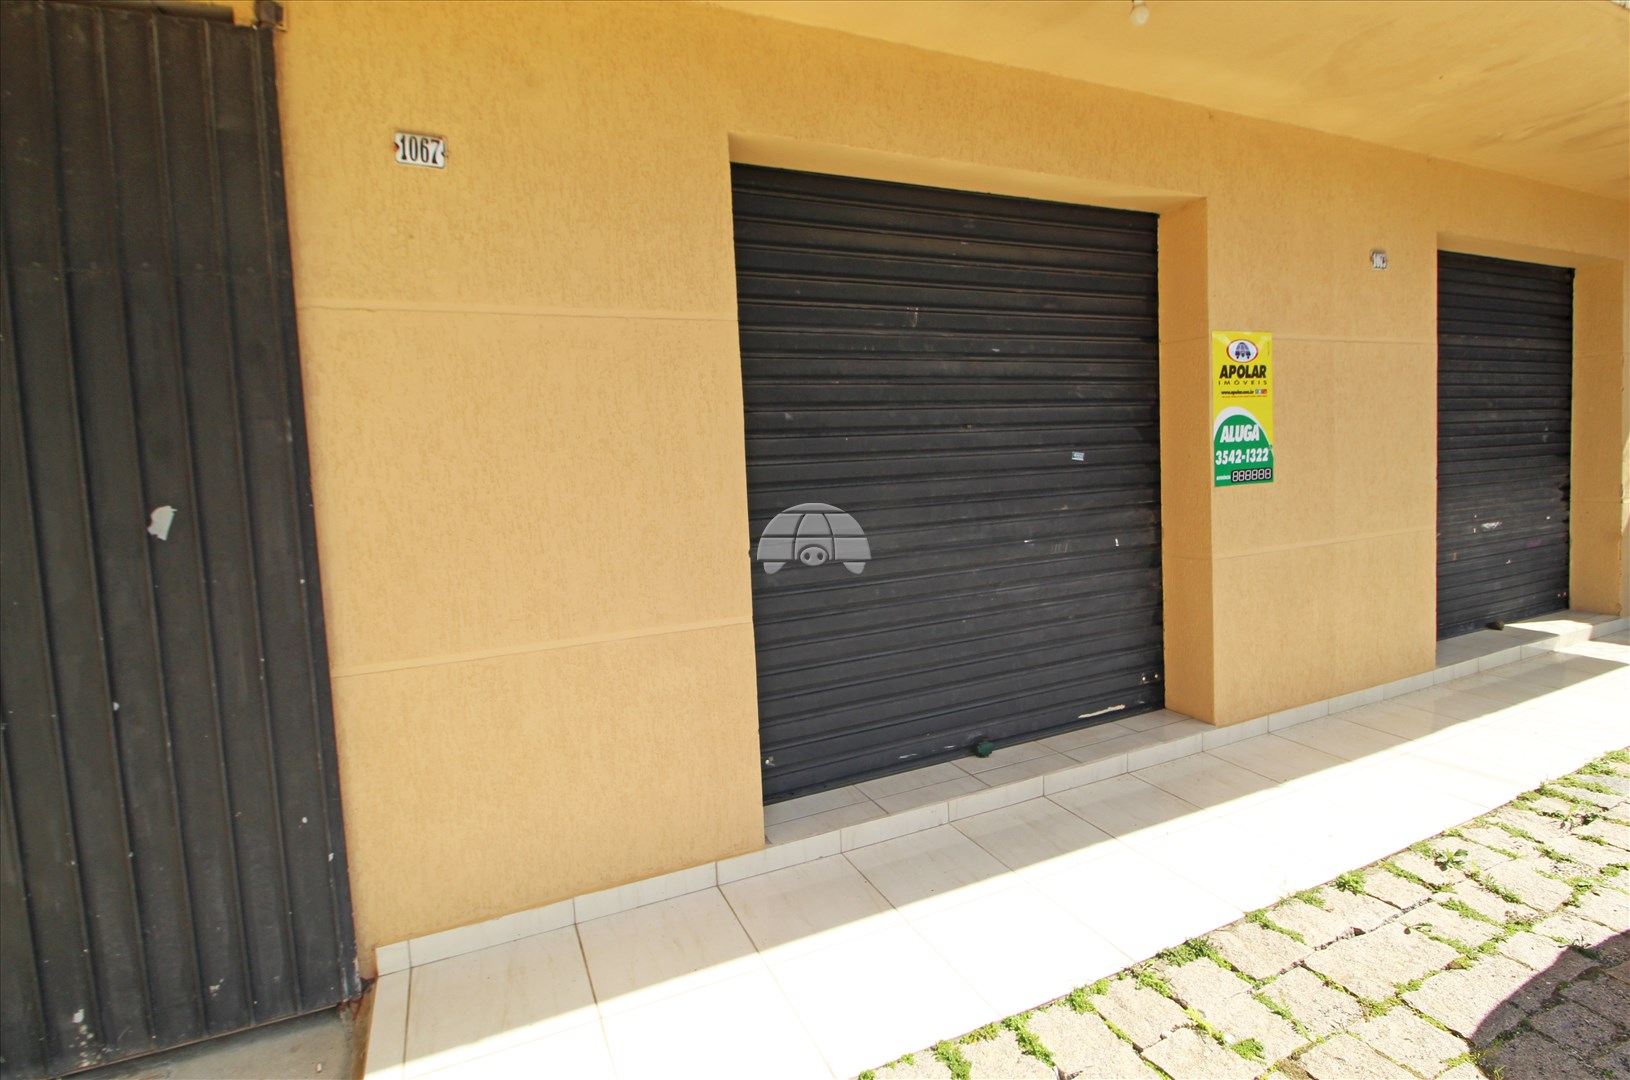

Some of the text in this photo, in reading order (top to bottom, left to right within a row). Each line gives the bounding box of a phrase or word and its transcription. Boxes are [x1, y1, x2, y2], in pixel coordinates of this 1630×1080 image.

[400, 134, 440, 164] 1067
[1219, 364, 1267, 379] APOLAR
[1219, 424, 1260, 443] ALUGA
[1215, 447, 1269, 465] 3542-1322
